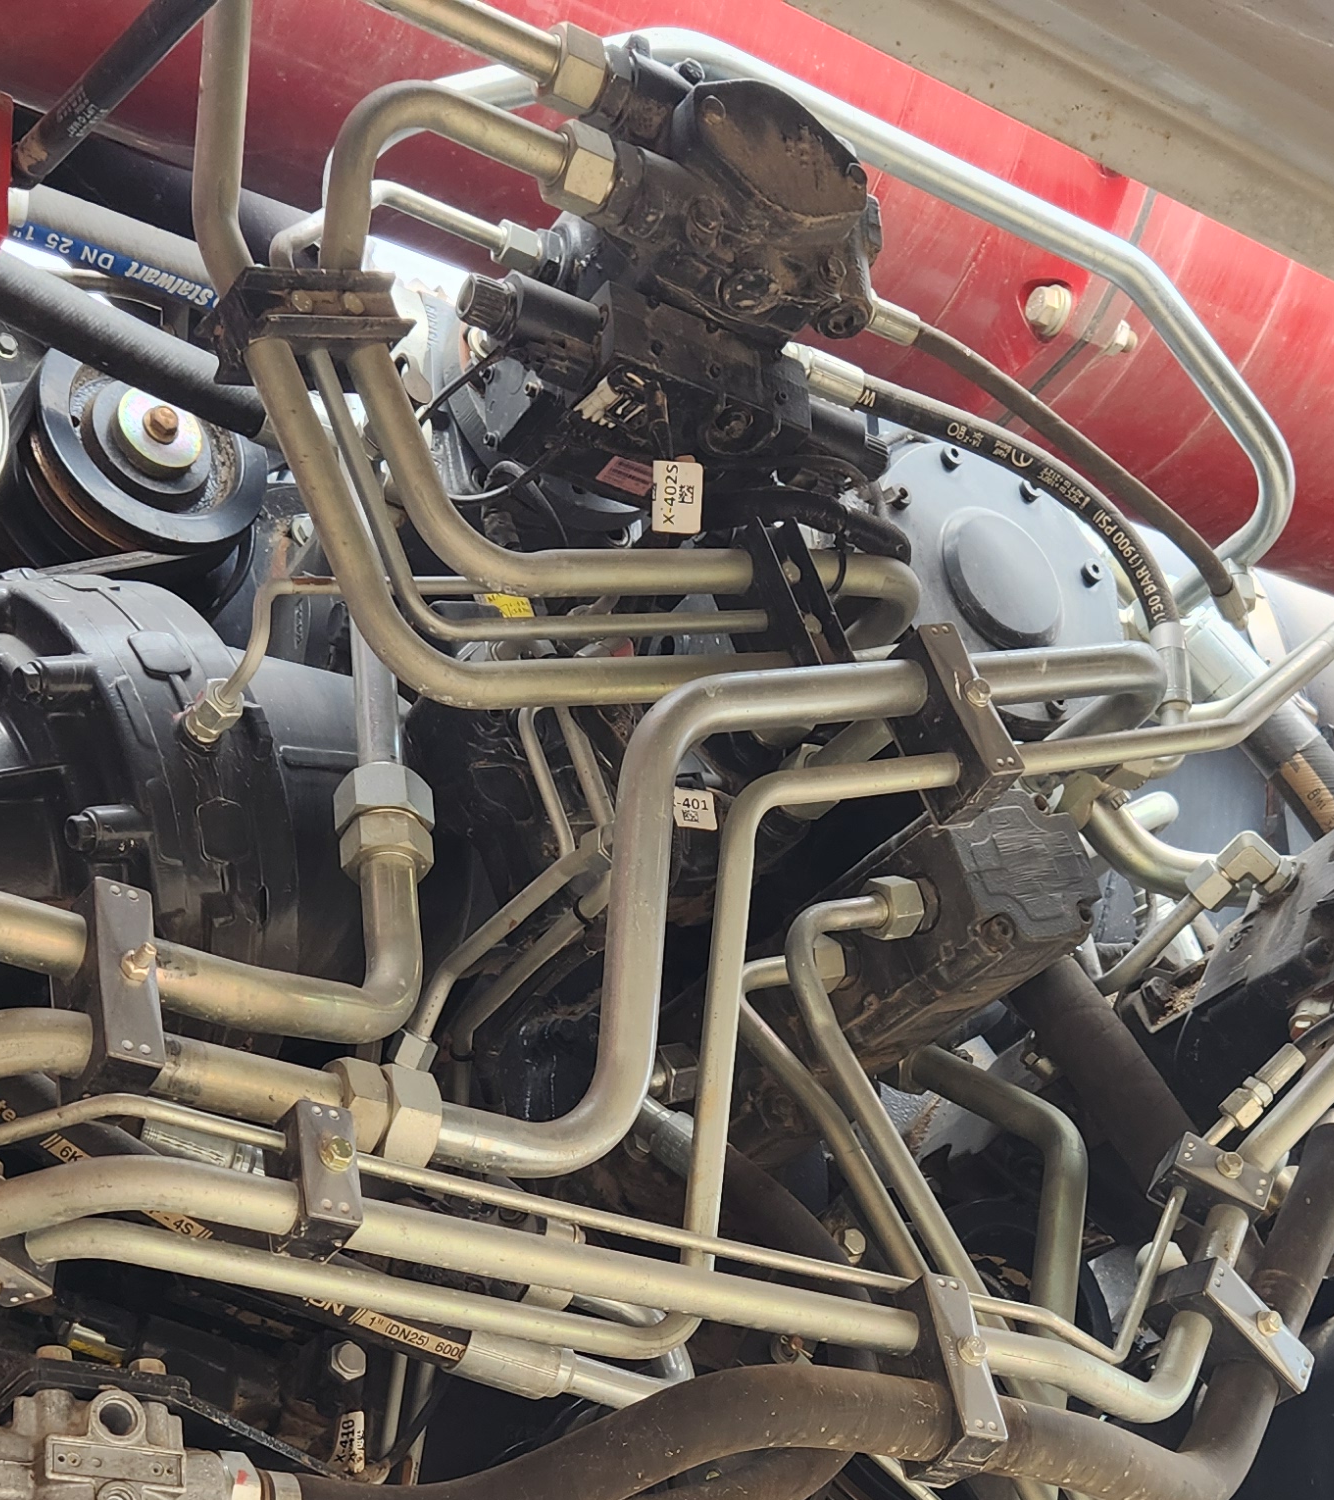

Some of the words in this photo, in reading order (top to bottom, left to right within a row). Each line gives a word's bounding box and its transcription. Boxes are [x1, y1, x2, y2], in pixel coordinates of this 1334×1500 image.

[44, 231, 74, 254] 25
[79, 244, 115, 270] DN
[122, 259, 215, 308] Stalwart
[661, 463, 679, 524] X-402S
[1091, 507, 1119, 535] PSI)
[1110, 528, 1144, 569] (1900
[1133, 564, 1159, 596] BAR
[672, 796, 708, 810] -401
[383, 1322, 430, 1348] (DN25)
